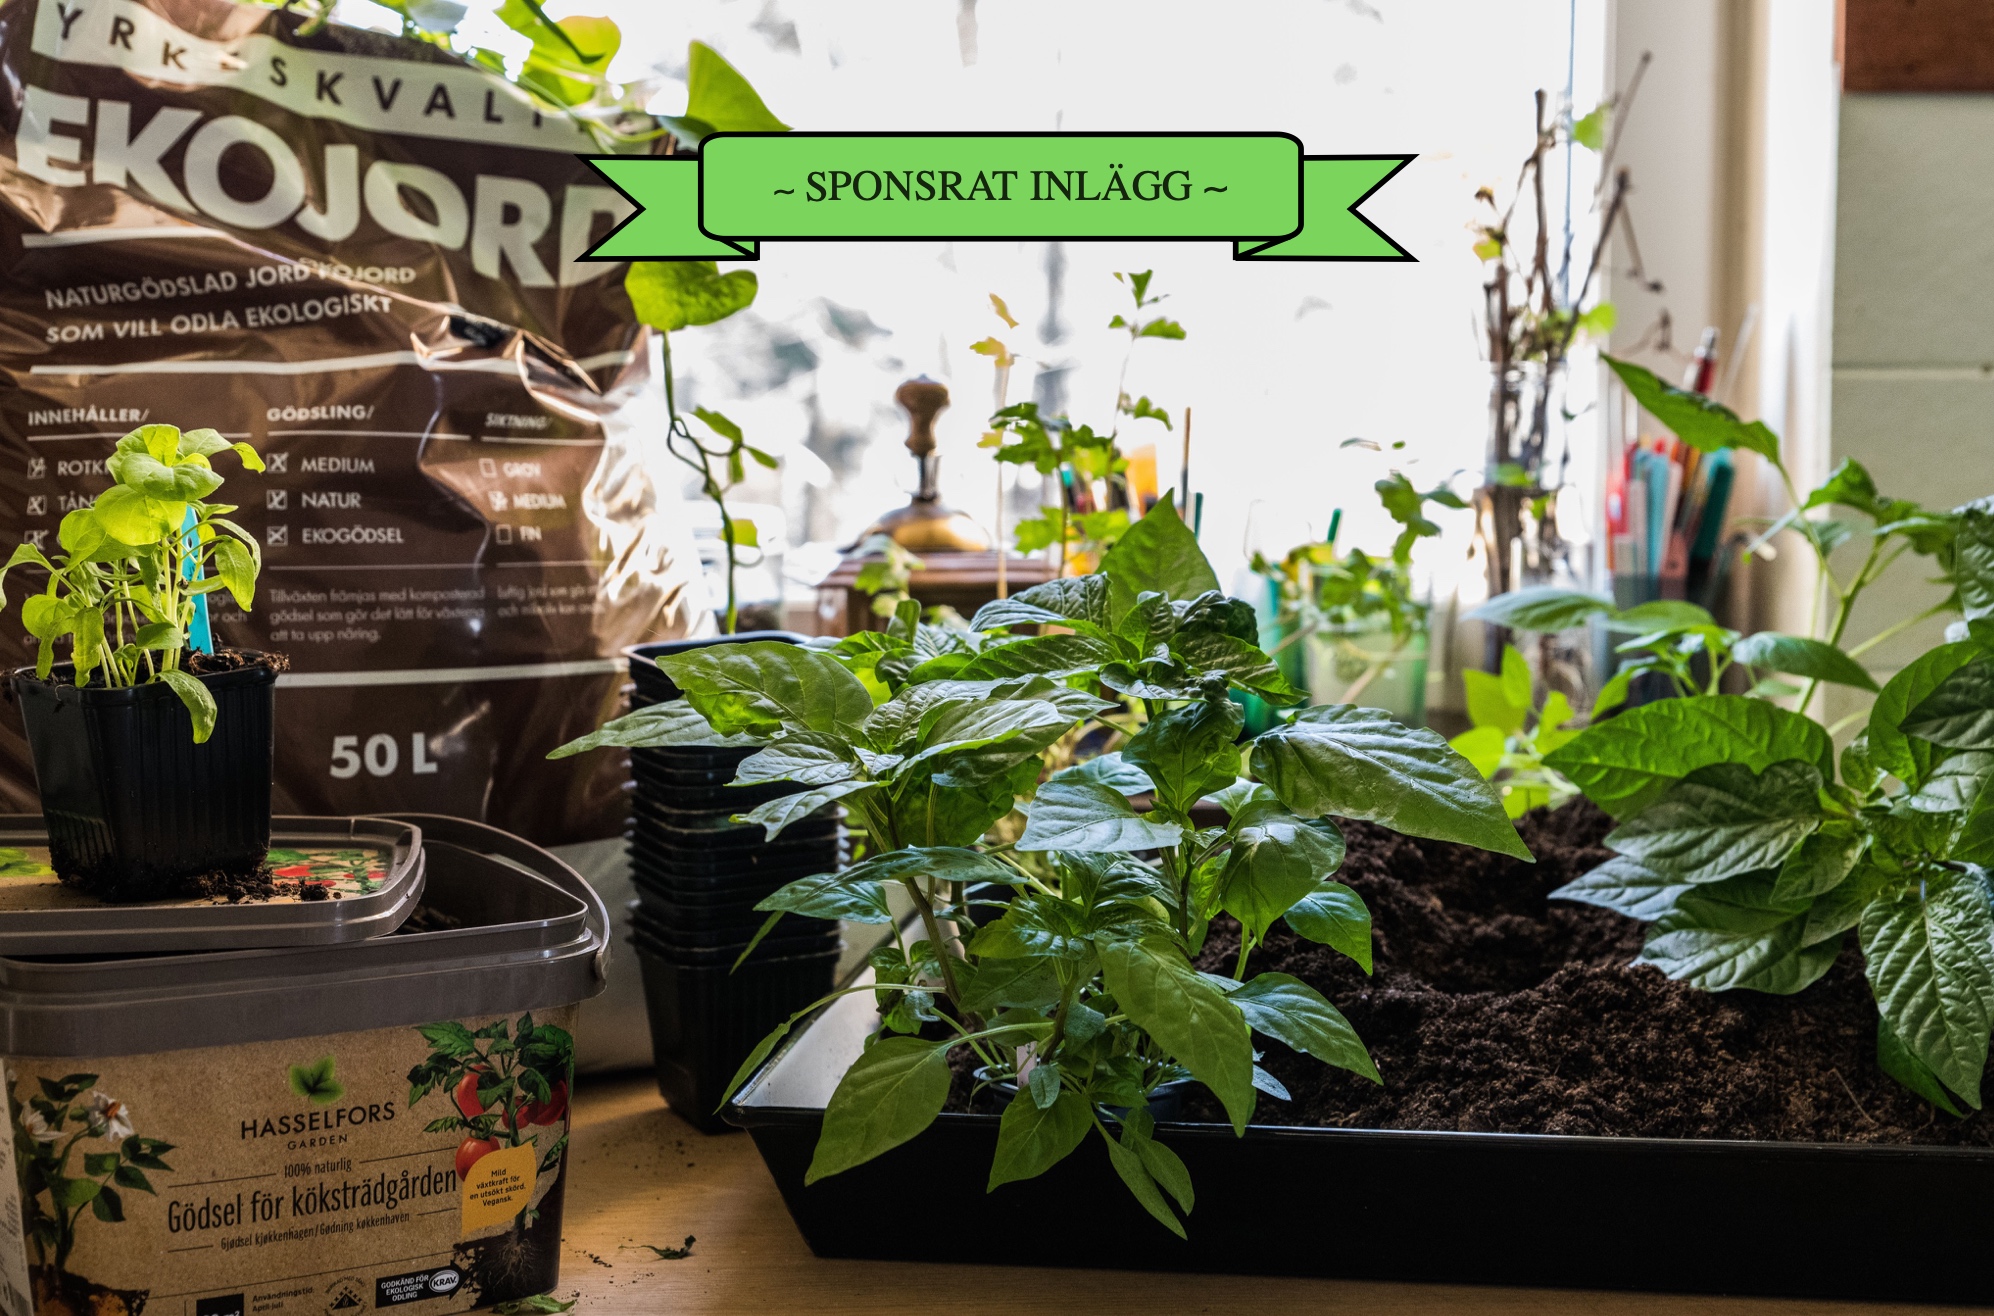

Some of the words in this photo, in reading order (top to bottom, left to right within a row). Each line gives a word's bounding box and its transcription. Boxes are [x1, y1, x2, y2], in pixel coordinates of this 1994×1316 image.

[45, 271, 238, 310] NATURGÖDSLAD
[246, 264, 311, 289] JORD
[46, 323, 104, 344] SOM
[113, 318, 163, 338] VILL
[170, 310, 240, 334] ODLA
[244, 293, 392, 329] EKOLOGISKT
[28, 404, 150, 426] INNEHÅLLER/
[266, 405, 375, 422] GÖDSLING/
[301, 457, 376, 474] MEDIUM
[57, 490, 101, 512] TÅN
[301, 492, 362, 509] NATUR
[512, 492, 567, 510] MEDIUM
[301, 524, 404, 544] EKOGÖDSEL
[379, 587, 407, 601] med
[269, 607, 314, 625] gödsel
[316, 609, 343, 622] som
[345, 607, 368, 624] gör
[307, 629, 334, 643] upp
[330, 735, 399, 779] 50
[411, 732, 437, 775] L
[241, 1101, 395, 1140] HASSELFORS
[287, 1133, 348, 1150] GARDEN
[284, 1163, 311, 1178] 100%
[314, 1157, 353, 1173] naturlig
[491, 1168, 507, 1177] Mild
[469, 1192, 479, 1200] en
[480, 1186, 503, 1198] utsökt
[505, 1182, 526, 1194] skörd.
[476, 1177, 508, 1190] växtkraft
[510, 1175, 520, 1184] för
[168, 1193, 242, 1233] Gödsel
[251, 1189, 285, 1223] för
[292, 1164, 457, 1218] köksträdgården
[482, 1195, 513, 1208] Vegansk.
[220, 1233, 253, 1250] Gjødsel
[356, 1212, 410, 1230] køkkenhaven
[381, 1277, 414, 1289] GODKÄND
[415, 1274, 429, 1283] FÖR
[385, 1283, 424, 1296] EKOLOGISK
[392, 1291, 417, 1302] ODLING
